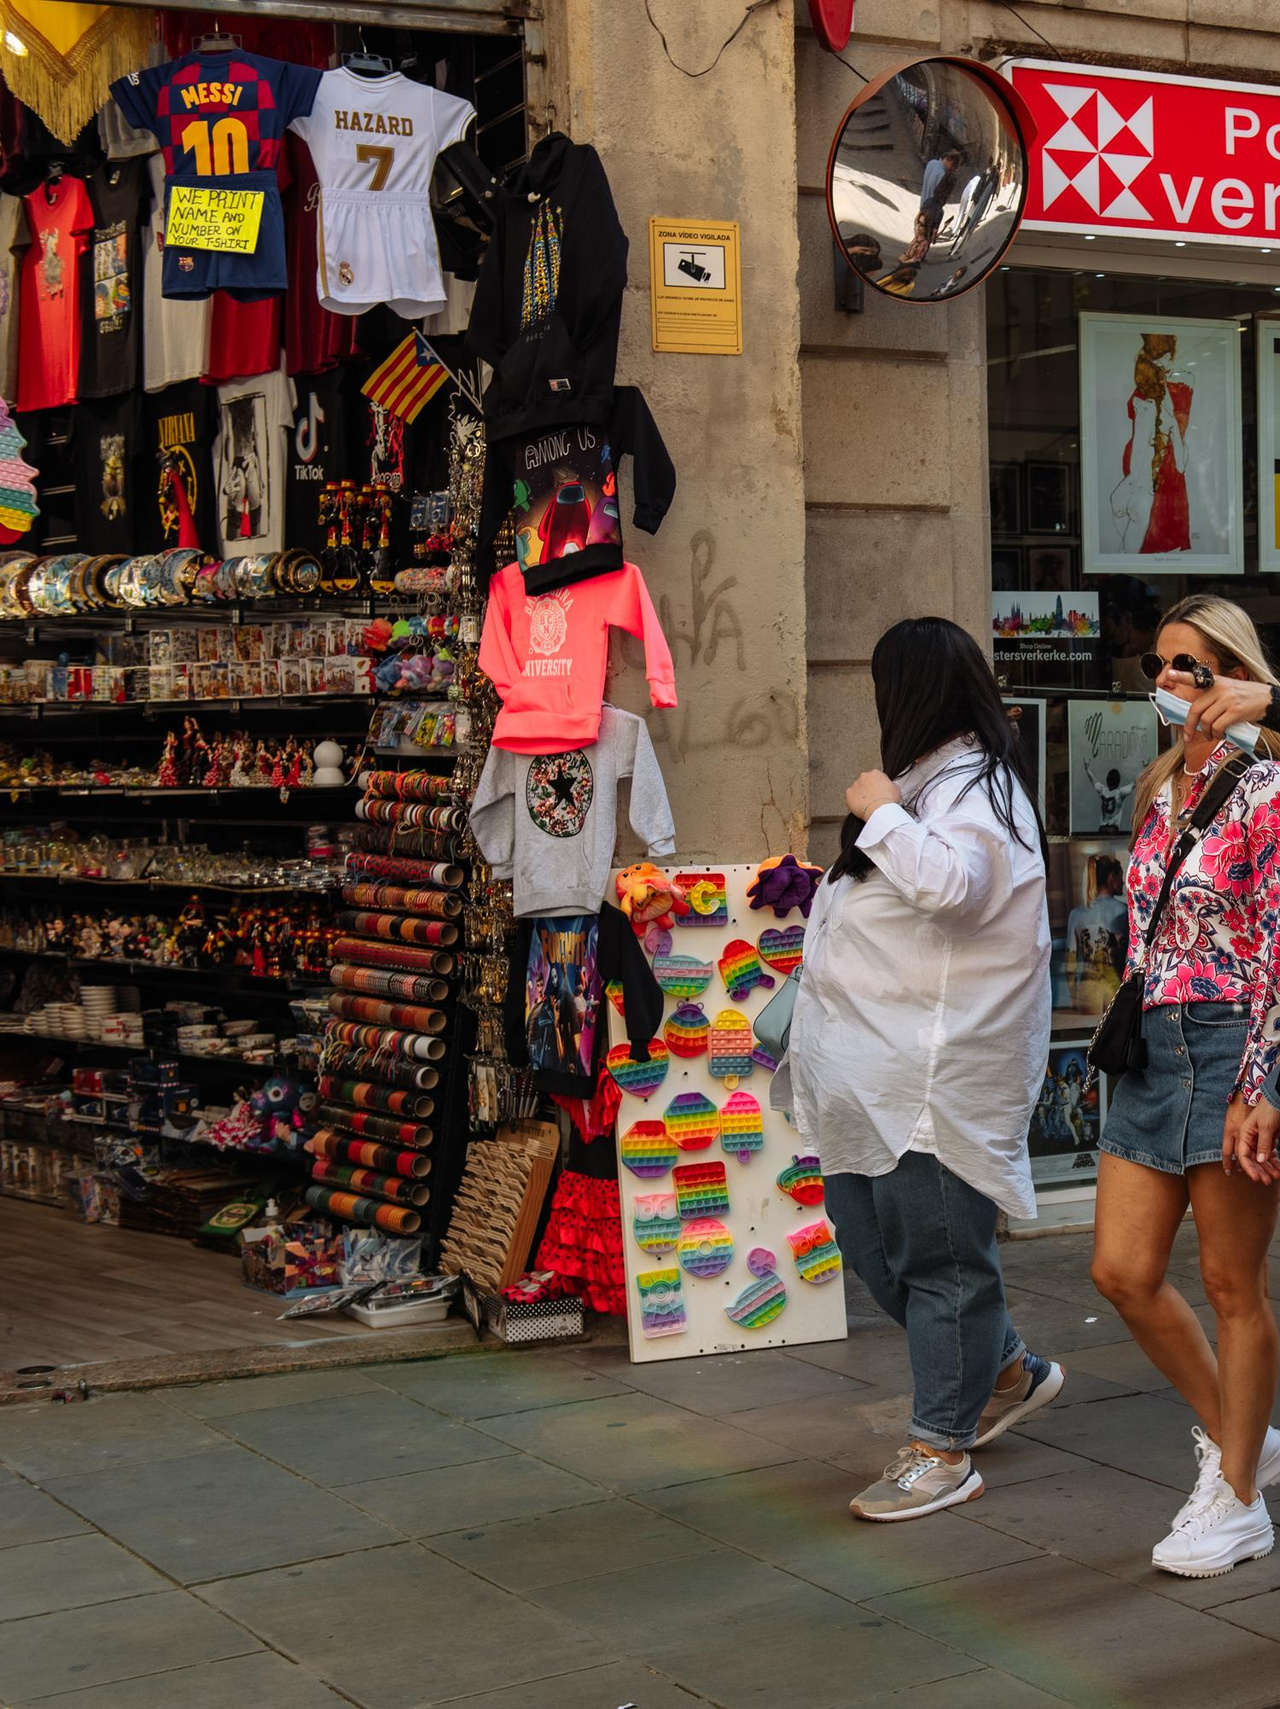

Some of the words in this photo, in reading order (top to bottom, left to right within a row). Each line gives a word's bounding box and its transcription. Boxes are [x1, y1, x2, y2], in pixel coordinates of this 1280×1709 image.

[180, 82, 243, 109] MESSI
[334, 109, 413, 137] HAZARD
[181, 117, 250, 176] 10
[355, 143, 395, 191] 7
[176, 187, 206, 205] WE
[207, 190, 261, 210] PRINT
[173, 206, 218, 223] NAME
[222, 211, 245, 223] AND
[169, 222, 222, 237] NUMBER
[225, 224, 243, 237] ON
[700, 233, 731, 241] VIGILADA
[172, 234, 199, 246] YOUR
[204, 237, 250, 250] T-SHIRT
[159, 411, 196, 447] NIRVANA
[525, 431, 571, 470] AMONG
[577, 425, 597, 451] US
[294, 465, 324, 481] TikTok
[993, 649, 1092, 661] stersverkerke.com
[522, 659, 573, 677] NIVERSITY
